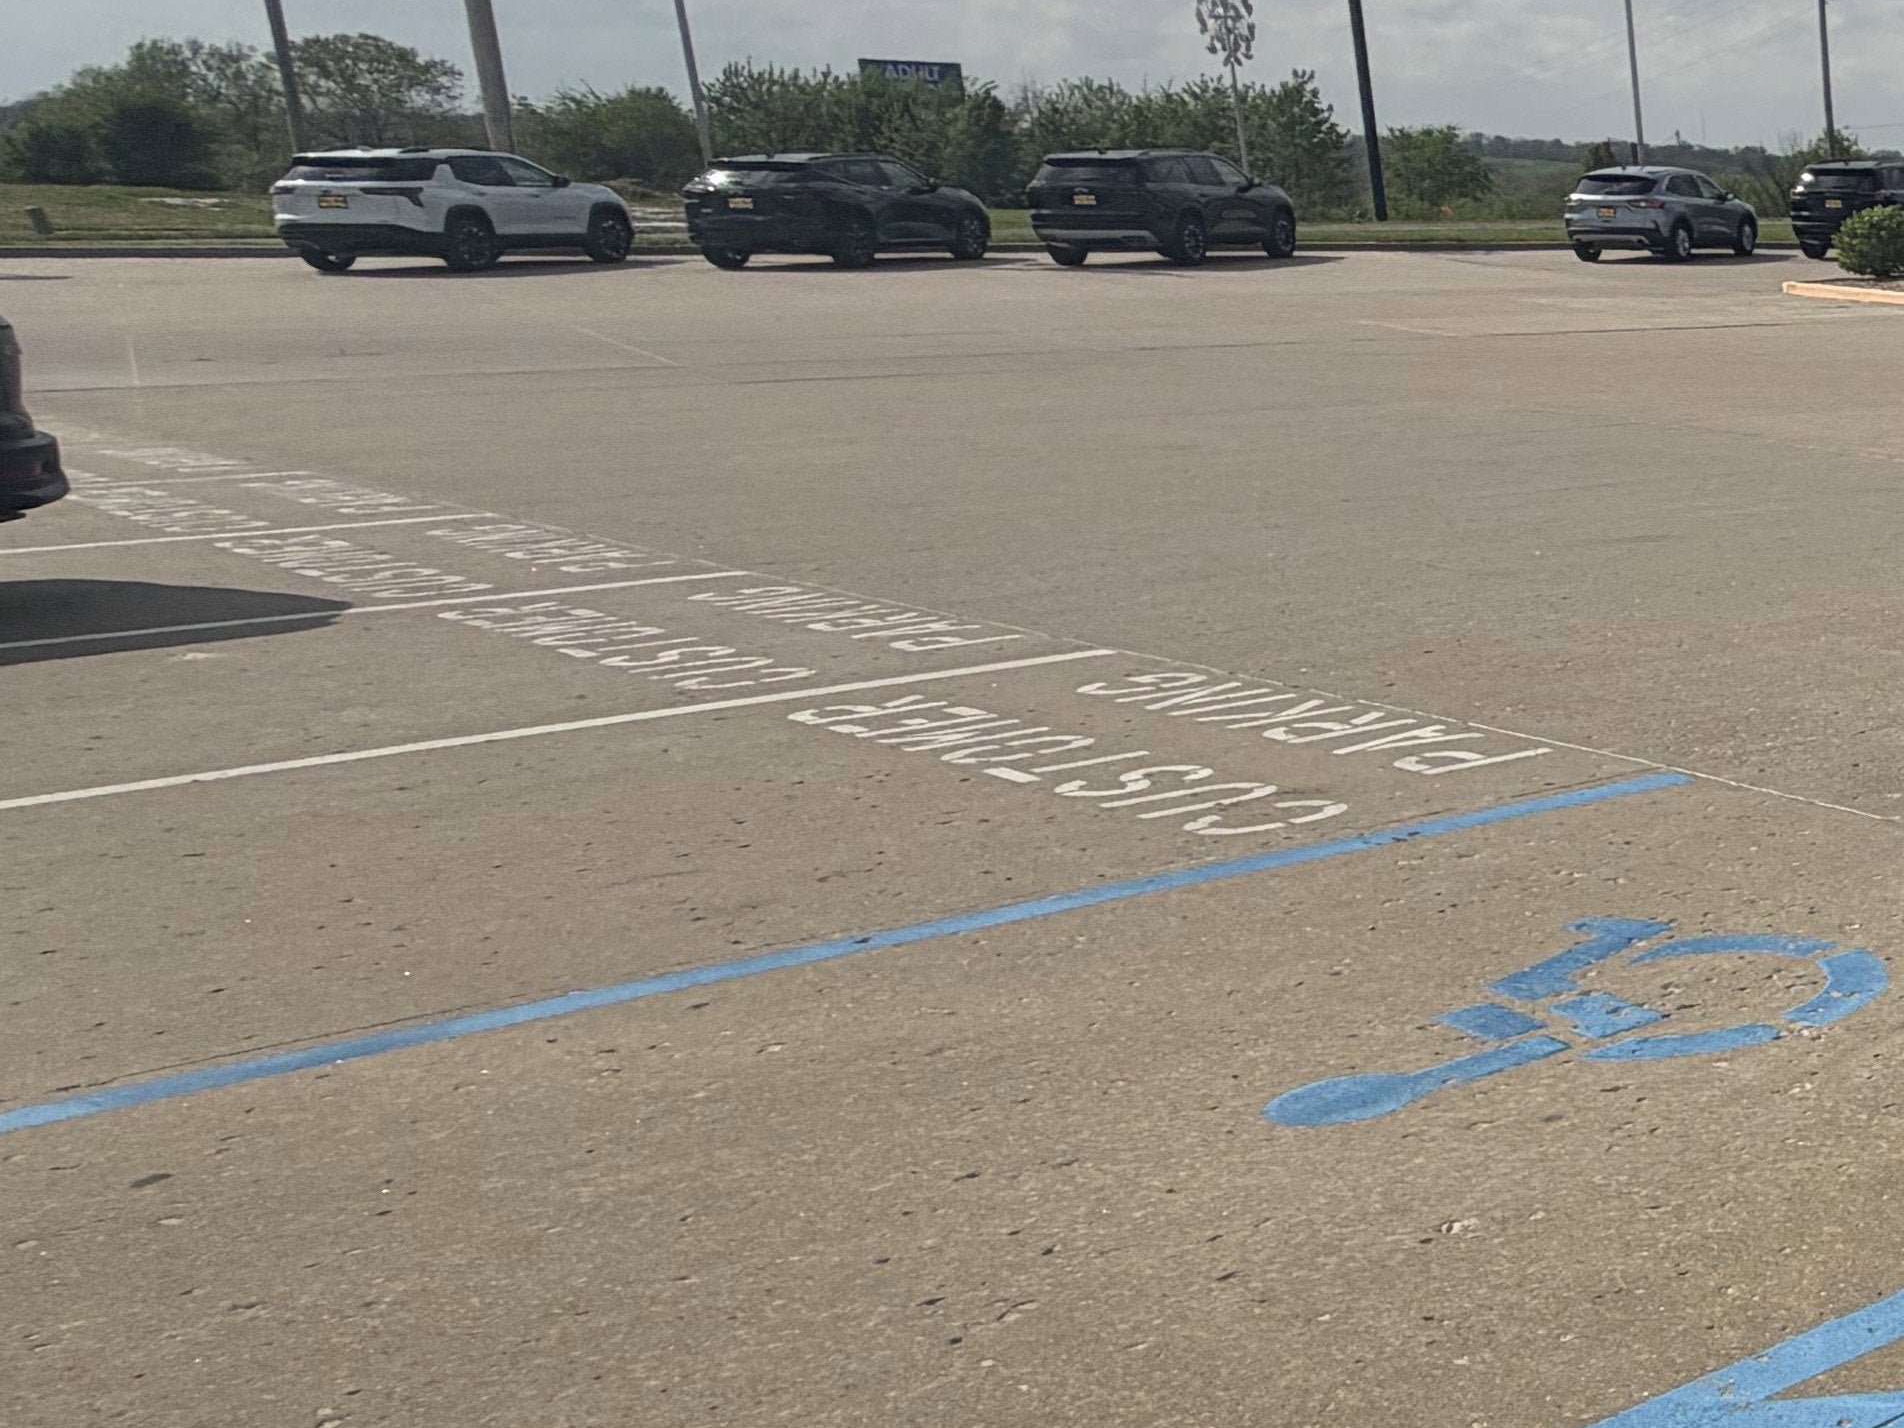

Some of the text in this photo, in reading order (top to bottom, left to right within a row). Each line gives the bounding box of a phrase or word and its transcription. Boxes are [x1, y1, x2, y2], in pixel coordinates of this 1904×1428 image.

[437, 601, 817, 690] CUSTOMER
[688, 585, 1027, 652] PARKING
[786, 694, 1349, 837] CUSTOMER
[1075, 671, 1553, 776] PARKING
